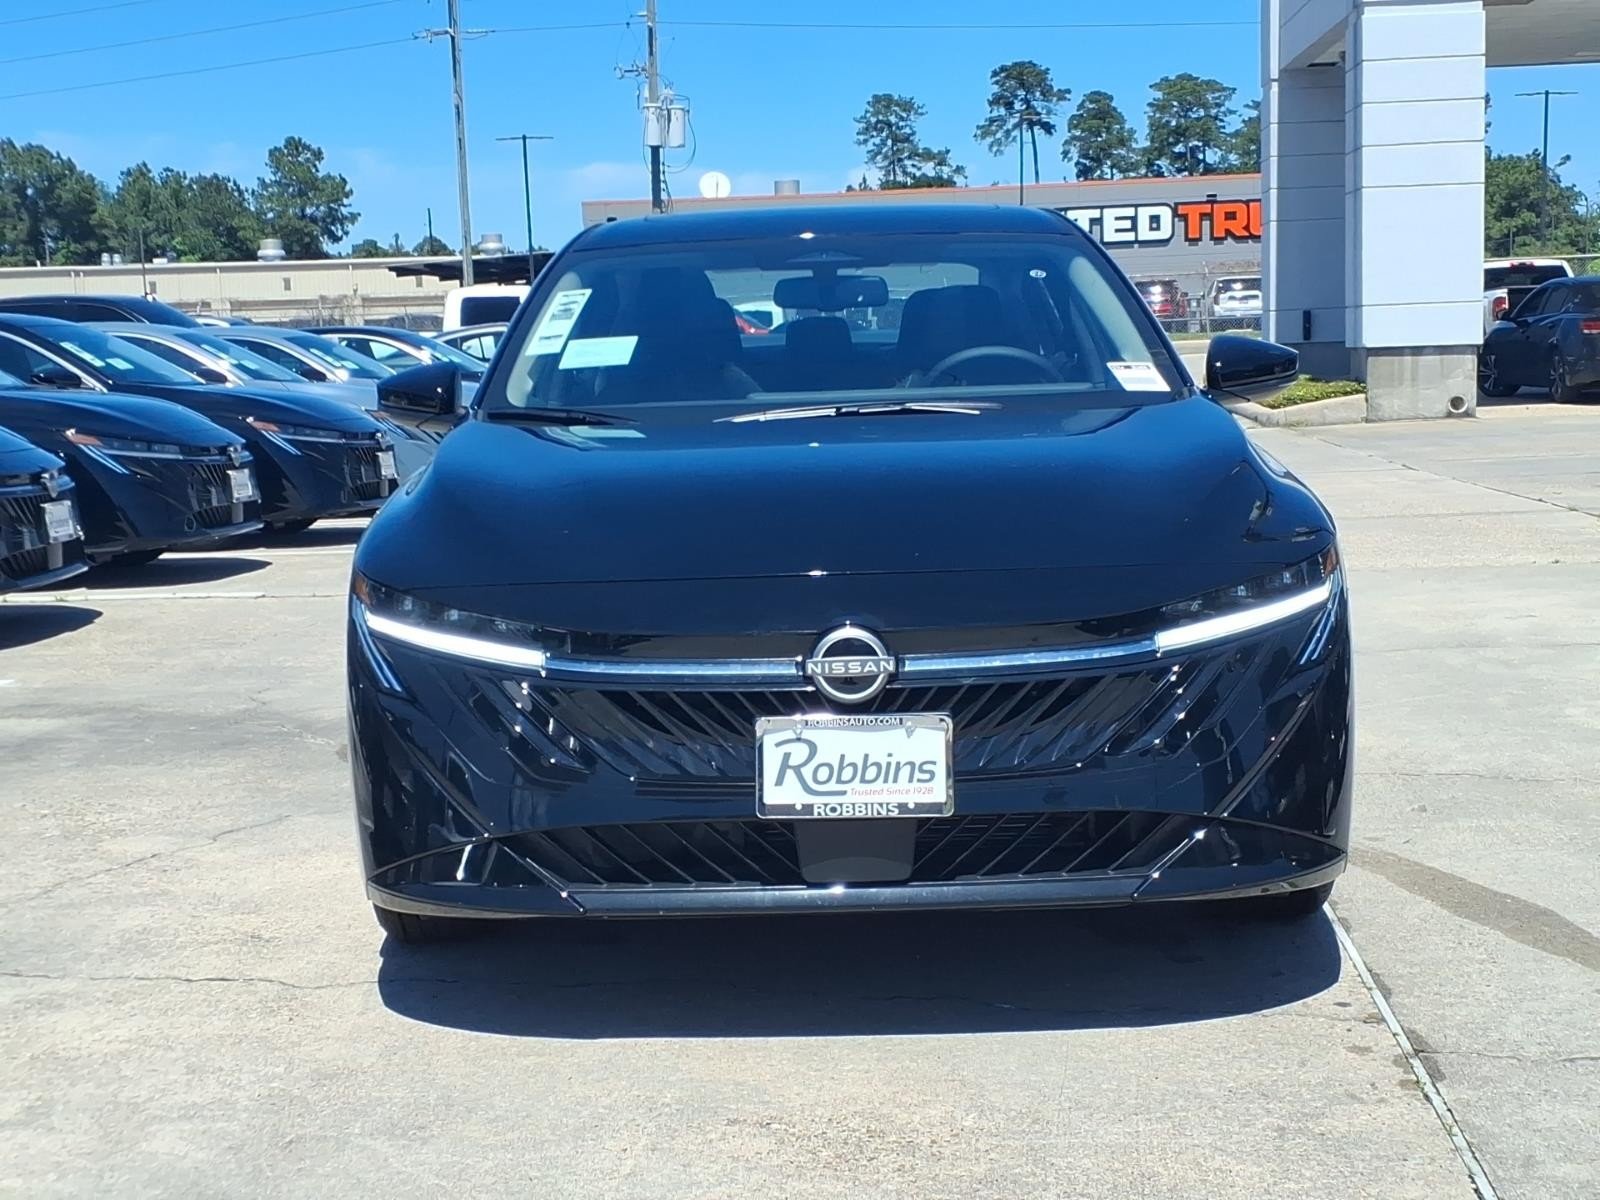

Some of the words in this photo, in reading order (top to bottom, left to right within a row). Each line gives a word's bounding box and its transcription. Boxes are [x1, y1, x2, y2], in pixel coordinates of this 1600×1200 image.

[1060, 205, 1173, 244] TED
[807, 660, 894, 674] NISSAN
[807, 717, 900, 728] ROBBINSAUTO.COM
[774, 738, 937, 796] Robbins
[851, 787, 884, 796] Trusted
[886, 786, 911, 796] Since
[913, 785, 934, 795] 1928
[813, 803, 899, 816] ROBBINS
